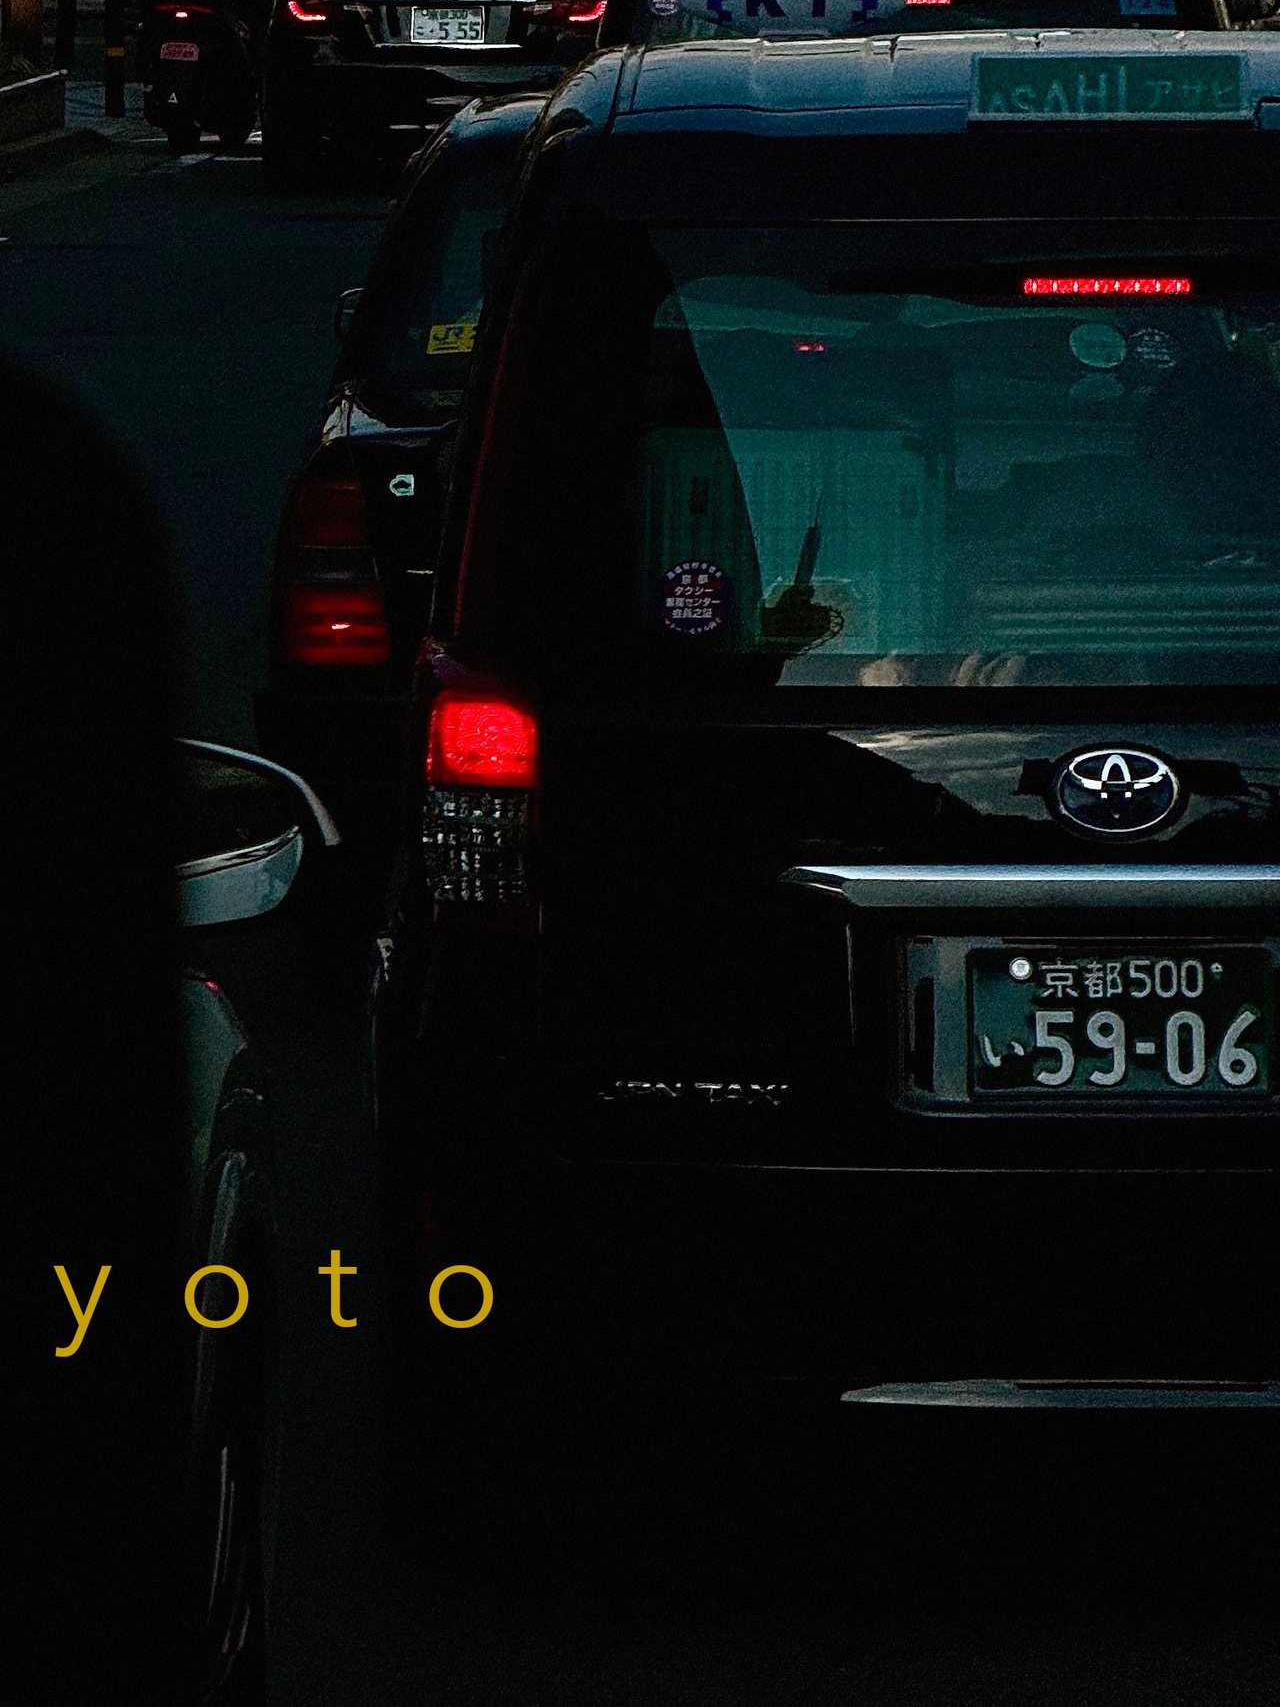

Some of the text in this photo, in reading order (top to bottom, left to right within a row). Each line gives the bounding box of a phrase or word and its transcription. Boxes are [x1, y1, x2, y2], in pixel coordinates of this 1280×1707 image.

[1037, 957, 1205, 998] 京都500
[980, 1009, 1261, 1087] い 59-06
